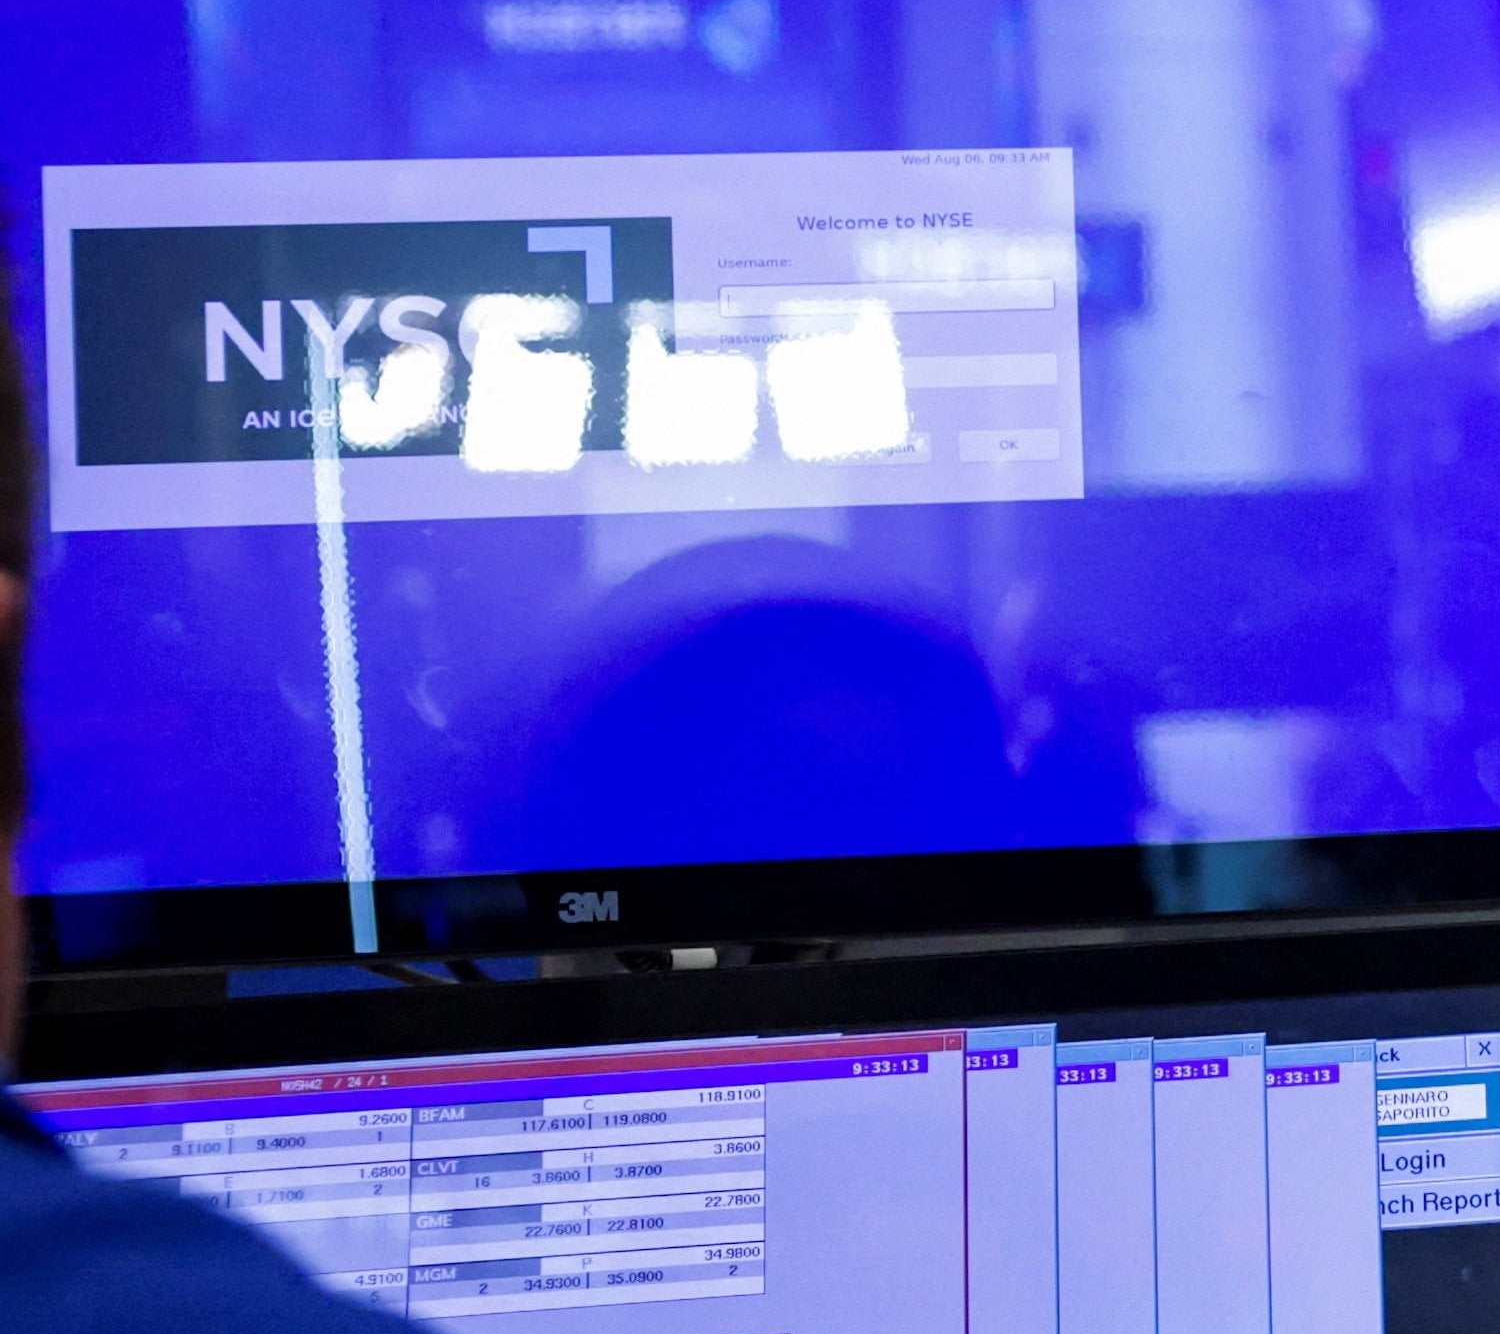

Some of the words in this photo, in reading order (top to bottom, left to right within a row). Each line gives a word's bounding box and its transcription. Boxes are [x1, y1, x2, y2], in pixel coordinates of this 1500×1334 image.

[901, 152, 930, 165] Wed
[935, 153, 960, 167] Aug
[1029, 151, 1050, 163] AM
[796, 215, 888, 231] Welcome
[895, 214, 915, 229] to
[923, 212, 974, 229] NYSE
[717, 257, 792, 270] Username:
[242, 410, 280, 429] AN
[999, 439, 1020, 451] OK
[558, 890, 619, 924] 3M
[852, 1058, 920, 1075] 9:33:13
[1154, 1063, 1220, 1080] 9:33:13
[1266, 1069, 1330, 1086] 9:33:13
[418, 1106, 465, 1123] BFAM
[698, 1088, 761, 1104] 118.9100
[358, 1112, 407, 1127] 9.2600
[522, 1116, 585, 1132] 117.6100
[603, 1111, 667, 1127] 119.0800
[118, 1148, 128, 1160] 2
[256, 1136, 306, 1151] 9.4000
[417, 1160, 458, 1176] CLVT
[713, 1140, 761, 1155] 3.8600
[1381, 1149, 1446, 1175] Login
[358, 1165, 406, 1180] 1.6800
[474, 1176, 490, 1189] 16
[532, 1170, 581, 1184] 3.8600
[614, 1164, 663, 1179] 3.8700
[373, 1184, 383, 1196] 2
[416, 1214, 452, 1229] GME
[705, 1193, 761, 1208] 22.7800
[524, 1222, 582, 1238] 22.7600
[607, 1217, 664, 1232] 22.8100
[415, 1267, 456, 1283] MGM
[704, 1246, 761, 1262] 34.9800
[354, 1272, 403, 1287] 4.9100
[479, 1283, 488, 1295] 2
[524, 1276, 581, 1292] 34.9300
[607, 1270, 664, 1286] 35.0900
[730, 1264, 739, 1277] 2
